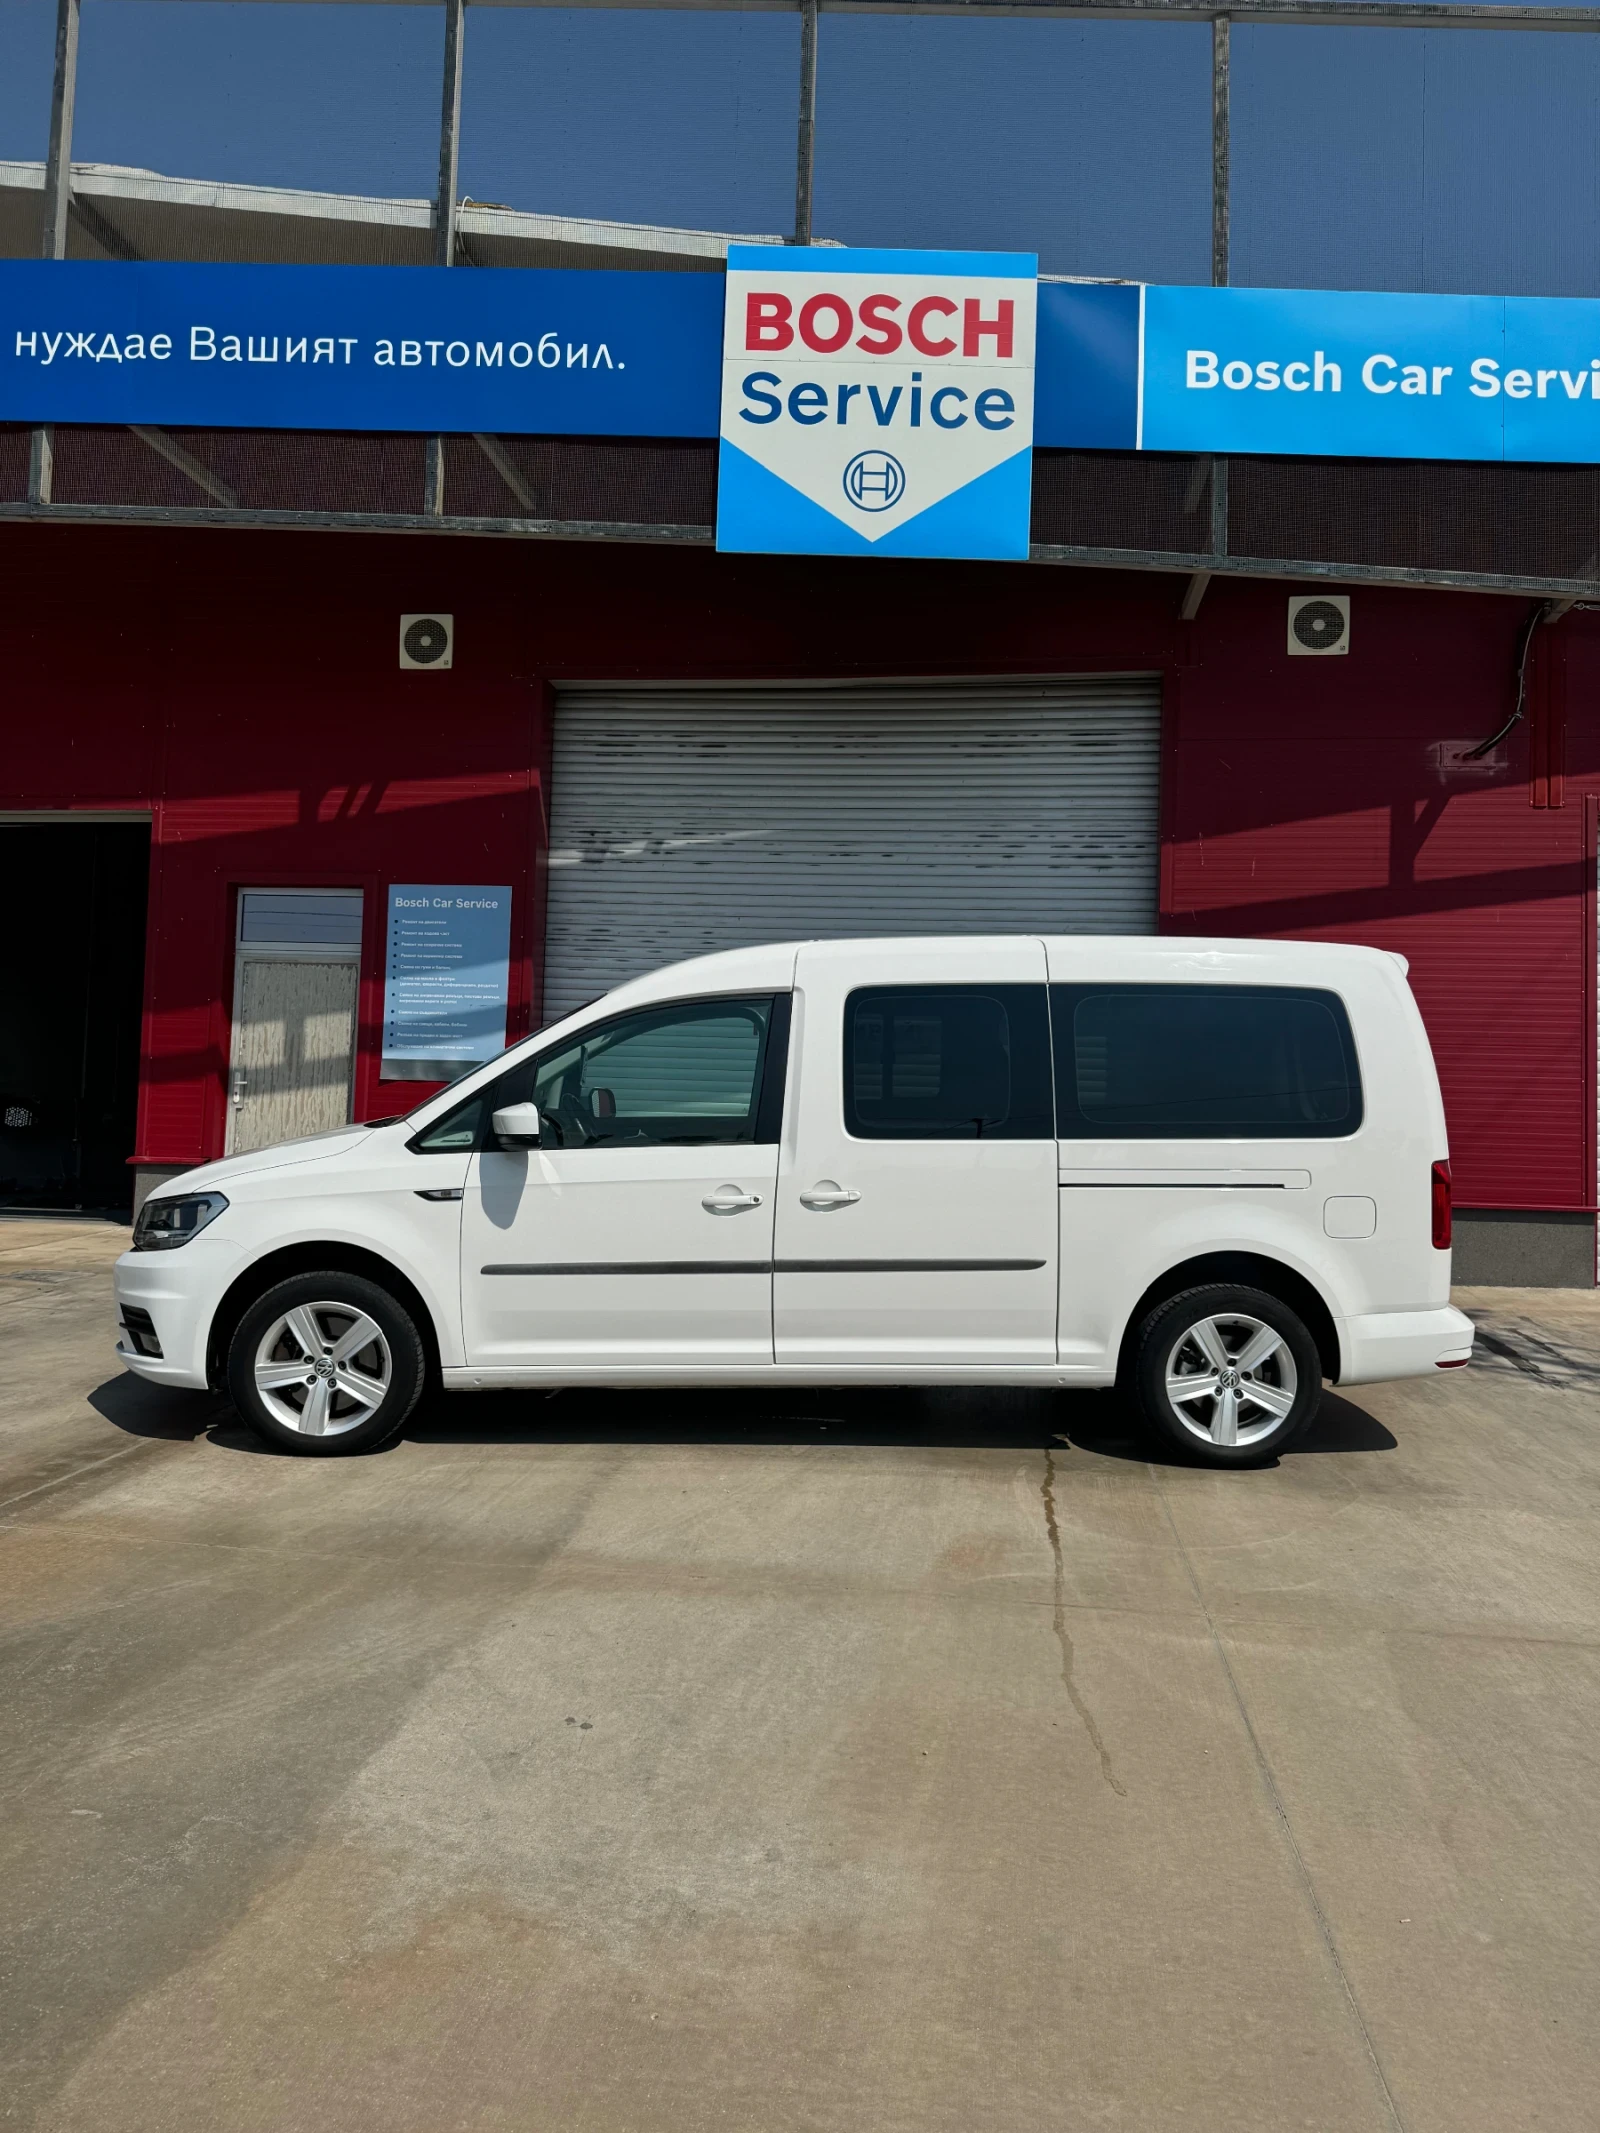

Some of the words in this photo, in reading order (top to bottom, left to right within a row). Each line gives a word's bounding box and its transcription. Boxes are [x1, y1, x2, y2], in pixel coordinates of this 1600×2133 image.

[15, 329, 172, 365] нуждае
[190, 326, 358, 364] Вашият
[373, 332, 626, 370] автомобил.
[745, 292, 1014, 358] BOSCH
[1186, 350, 1342, 392] Bosch
[1362, 354, 1453, 395] Car
[1469, 358, 1600, 400] Servi
[738, 371, 1015, 431] Service
[395, 897, 429, 908] Bosch
[432, 898, 452, 908] Car
[455, 898, 499, 909] Service
